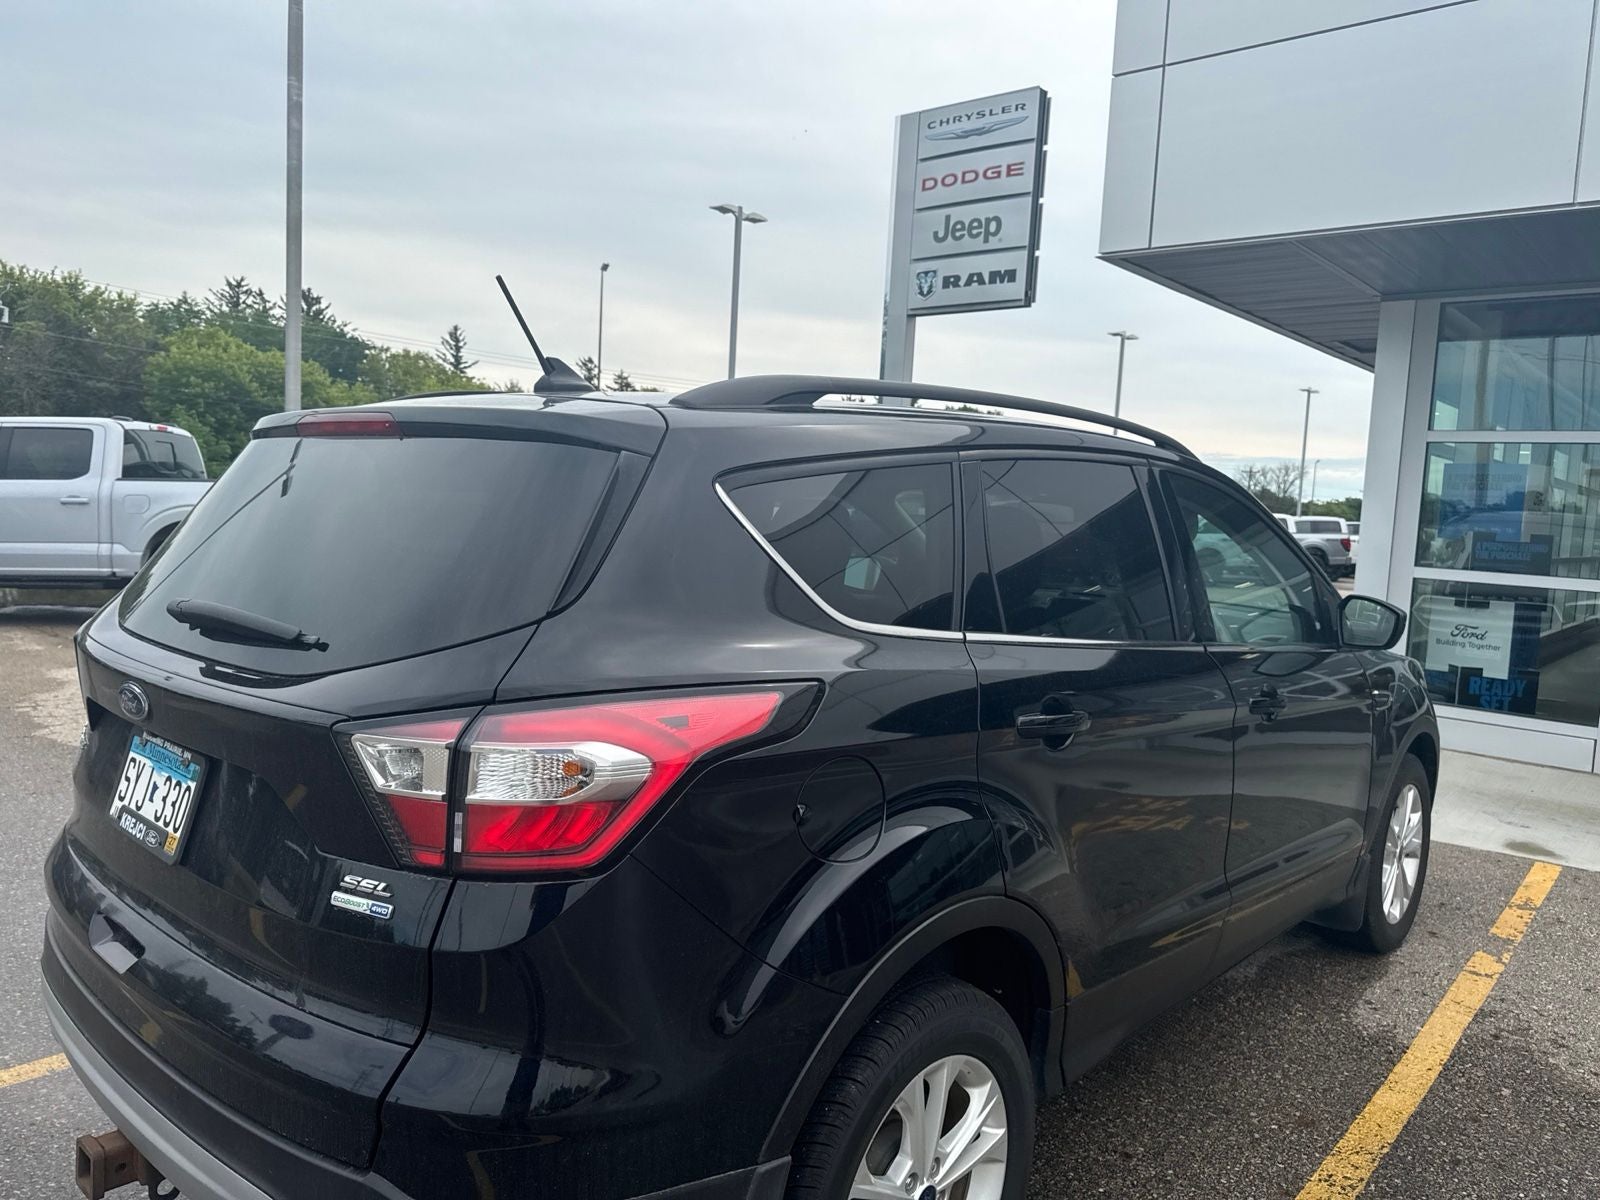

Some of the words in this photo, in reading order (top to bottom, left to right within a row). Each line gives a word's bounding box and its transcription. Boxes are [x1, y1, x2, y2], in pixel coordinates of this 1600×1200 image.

[927, 102, 1027, 130] CHRYSLER
[921, 161, 1026, 192] DODGE
[932, 214, 1003, 244] Jeep
[941, 268, 1017, 290] RAM
[1450, 623, 1488, 641] Ford
[1436, 638, 1466, 649] Building
[1468, 641, 1501, 652] Together
[1468, 676, 1527, 698] READY
[118, 757, 155, 812] SYJ
[154, 775, 192, 834] 330
[119, 811, 147, 841] KREJCI
[340, 875, 391, 897] SEL
[371, 905, 388, 915] 4WD
